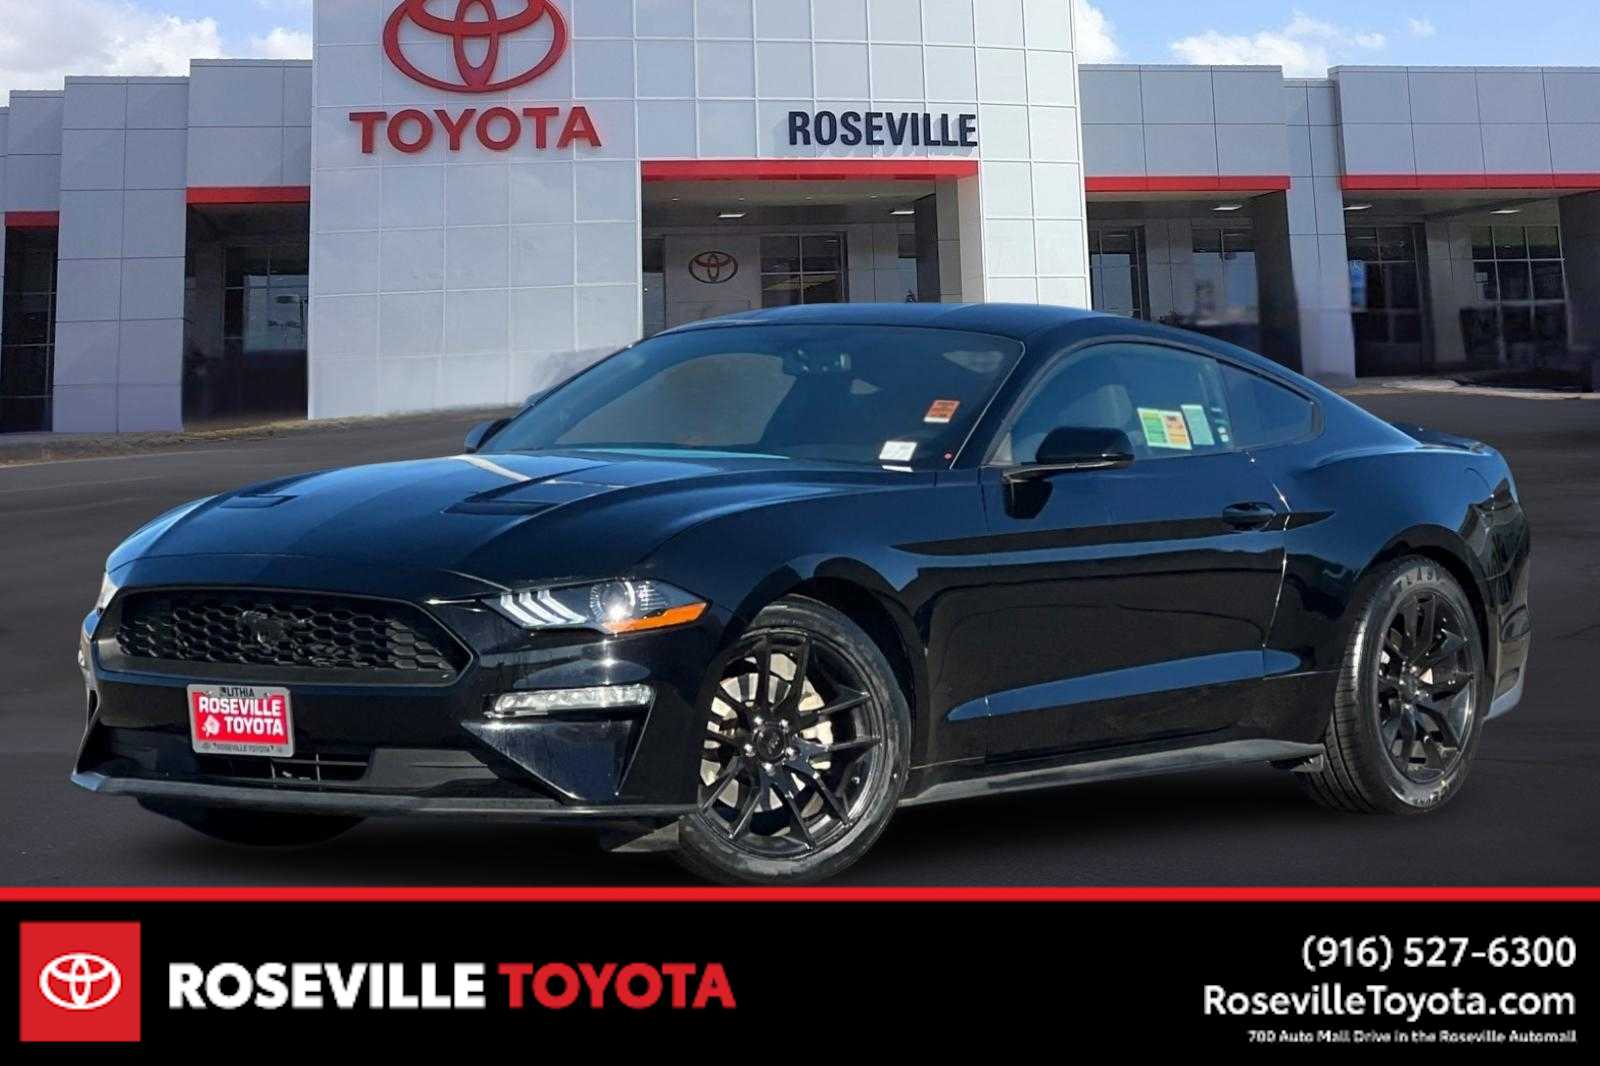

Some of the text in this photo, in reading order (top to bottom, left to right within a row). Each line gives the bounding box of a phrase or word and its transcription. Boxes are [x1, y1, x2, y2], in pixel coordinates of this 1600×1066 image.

[349, 106, 602, 154] TOYOTA
[788, 110, 979, 147] ROSEVILLE
[199, 696, 282, 717] ROSEVILLE
[224, 716, 285, 736] TOYOTA
